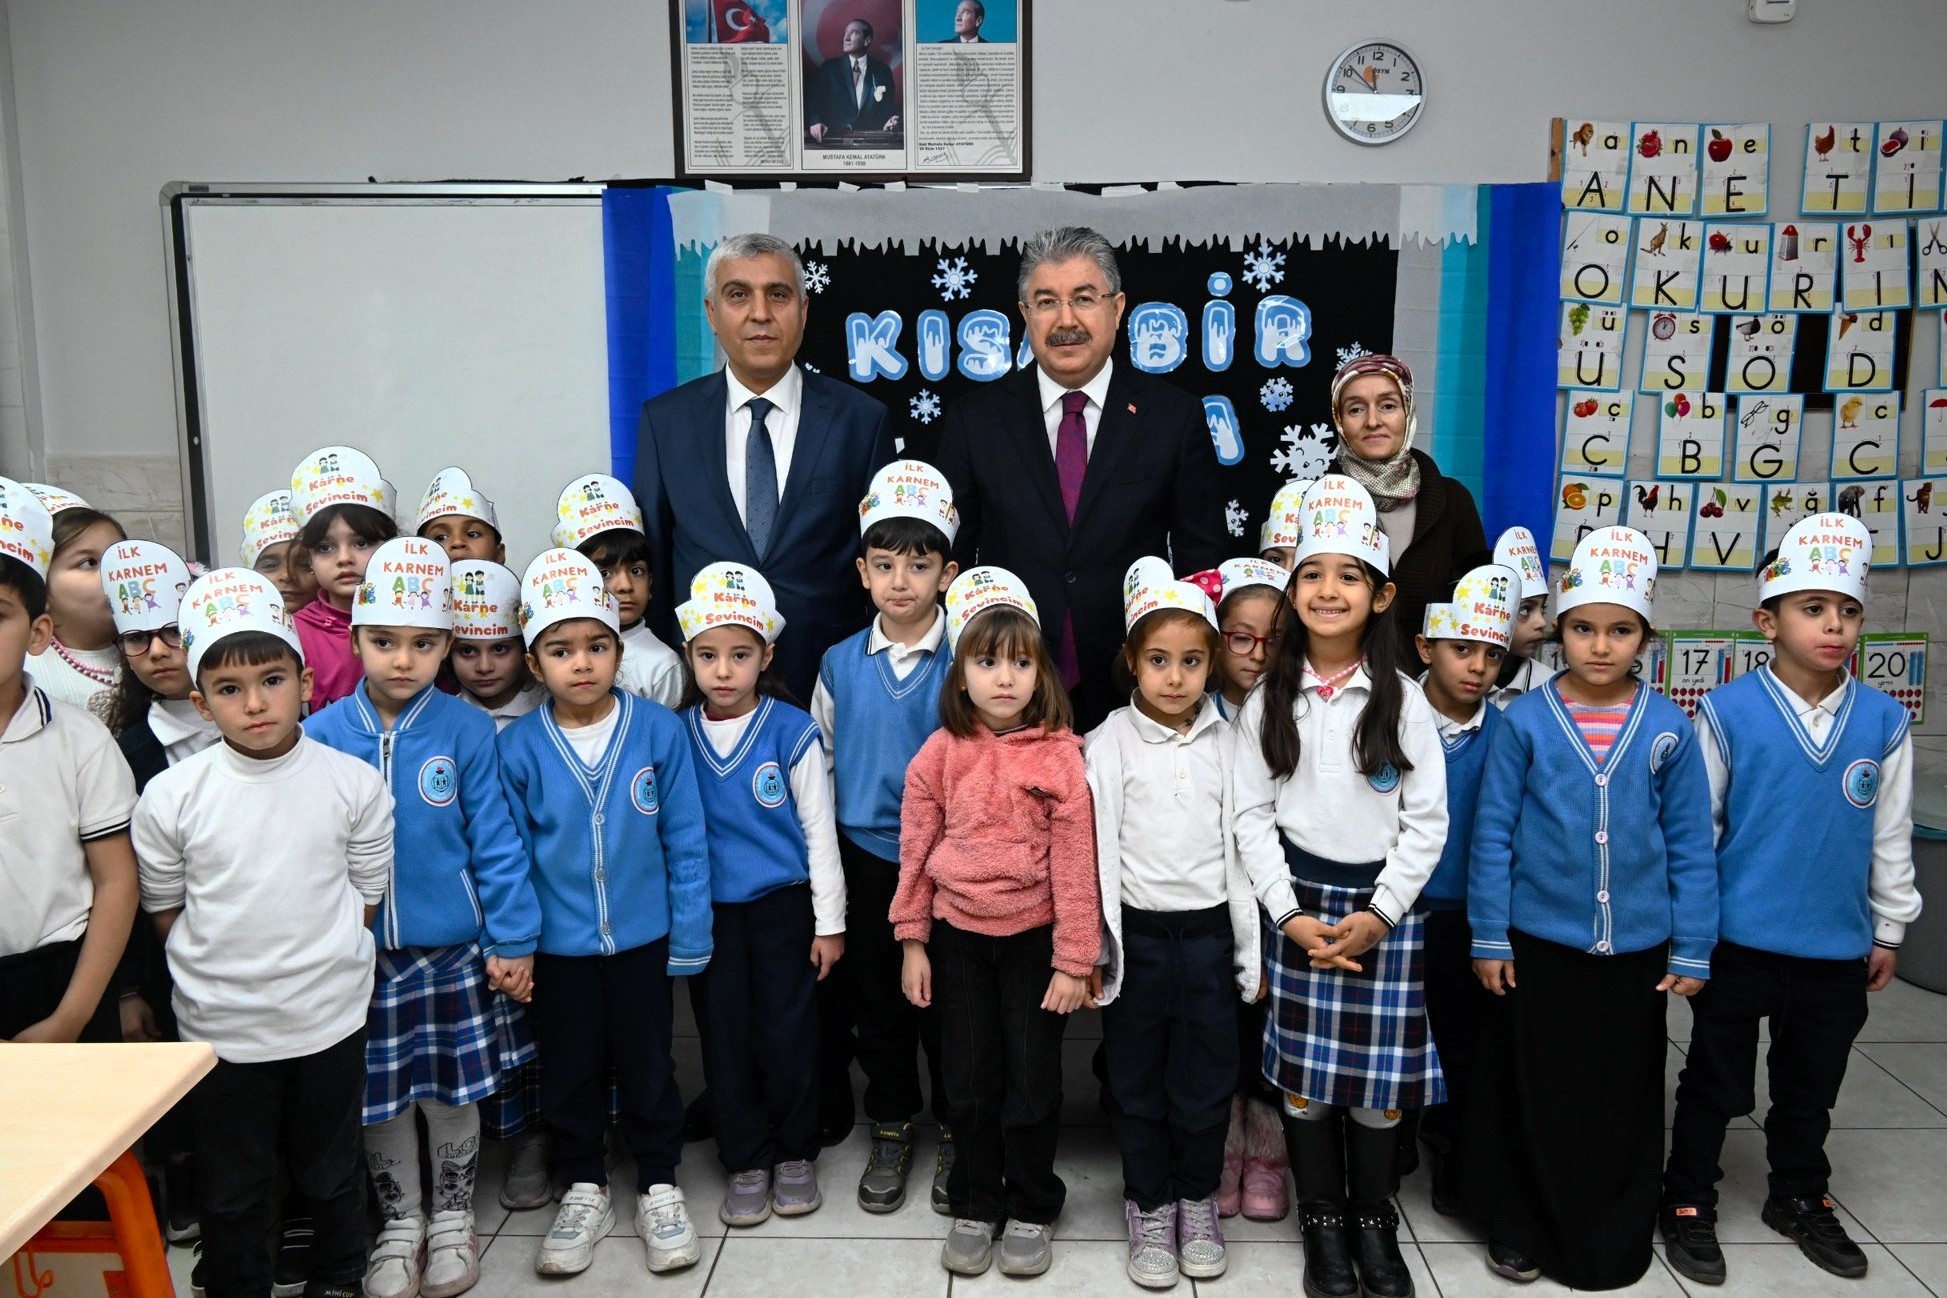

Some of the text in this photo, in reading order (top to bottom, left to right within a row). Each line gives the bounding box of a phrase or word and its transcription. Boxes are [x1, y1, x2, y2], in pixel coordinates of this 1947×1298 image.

[1358, 56, 1365, 65] 11
[1372, 51, 1384, 61] 12
[1393, 58, 1397, 68] 1
[1342, 68, 1353, 78] 10
[1400, 72, 1410, 82] 2
[1336, 85, 1346, 93] 9
[1366, 123, 1376, 133] 6
[1605, 136, 1618, 149] a
[1675, 140, 1687, 153] n
[1744, 140, 1756, 153] e
[1850, 128, 1860, 152] t
[1920, 130, 1925, 150] i
[1577, 172, 1605, 207] A
[1646, 176, 1676, 211] N
[1726, 176, 1747, 212] E
[1826, 175, 1849, 210] T
[1606, 230, 1618, 244] o
[1680, 223, 1691, 250] k
[1815, 238, 1827, 251] r
[1746, 240, 1758, 254] u
[1575, 264, 1608, 298] O
[1655, 270, 1679, 305] K
[1722, 275, 1748, 310] U
[1794, 274, 1813, 308] R
[1128, 271, 1312, 374] BİR
[1690, 320, 1699, 333] s
[1771, 315, 1784, 334] ö
[1869, 312, 1883, 331] d
[1664, 355, 1685, 389] S
[1848, 353, 1875, 387] D
[1702, 393, 1715, 418] b
[1875, 406, 1887, 419] c
[1777, 410, 1789, 434] g
[1681, 440, 1701, 474] B
[1750, 444, 1783, 478] G
[1850, 441, 1879, 475] C
[904, 462, 924, 472] İLK
[887, 476, 939, 490] KARNEM
[1324, 479, 1345, 490] İLK
[306, 491, 368, 514] Sevincim
[1308, 498, 1363, 511] KARNEM
[1597, 493, 1611, 517] p
[1670, 485, 1681, 511] h
[1737, 499, 1750, 511] v
[1874, 486, 1886, 512] f
[580, 501, 619, 518] Karne
[260, 518, 296, 530] Karn
[578, 518, 634, 539] Sevincim
[1820, 516, 1844, 528] İLK
[1610, 529, 1633, 542] İLK
[1798, 534, 1862, 550] KARNEM
[1926, 527, 1942, 560] J
[118, 546, 141, 560] İLK
[405, 540, 428, 555] İLK
[1590, 548, 1649, 565] KARNEM
[1712, 532, 1740, 565] V
[546, 552, 567, 564] İLK
[108, 562, 168, 582] KARNEM
[209, 572, 236, 584] İLK
[383, 562, 444, 576] KARNEM
[532, 566, 588, 587] KARNEM
[192, 584, 264, 610] KARNEM
[454, 599, 497, 613] Karne
[714, 592, 757, 607] Karne
[961, 596, 1023, 621] Sevincim
[1474, 602, 1511, 621] Karne
[705, 611, 764, 631] Sevincim
[1682, 650, 1710, 675] 17
[1868, 652, 1906, 678] 20
